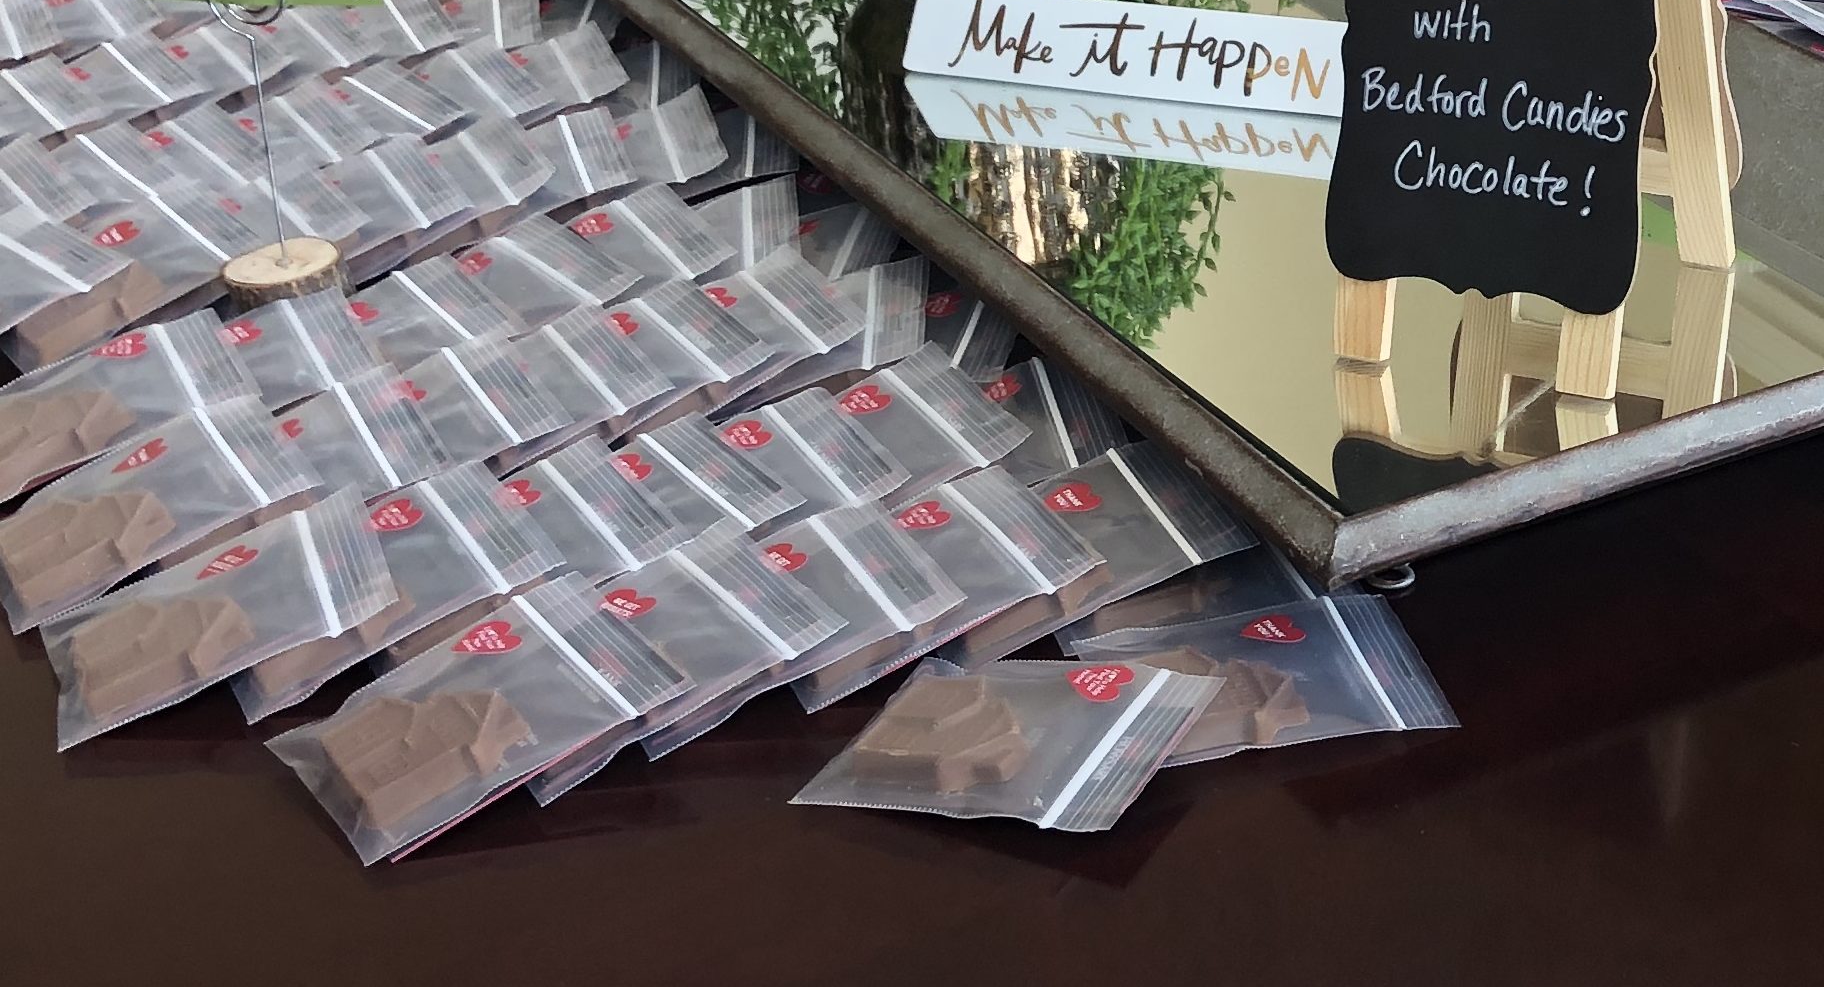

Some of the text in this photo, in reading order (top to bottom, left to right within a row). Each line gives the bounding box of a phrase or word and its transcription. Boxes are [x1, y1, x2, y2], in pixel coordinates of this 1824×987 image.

[1059, 12, 1146, 78] it
[1361, 65, 1628, 143] Bedford Candies
[1393, 139, 1598, 218] Chocolate!
